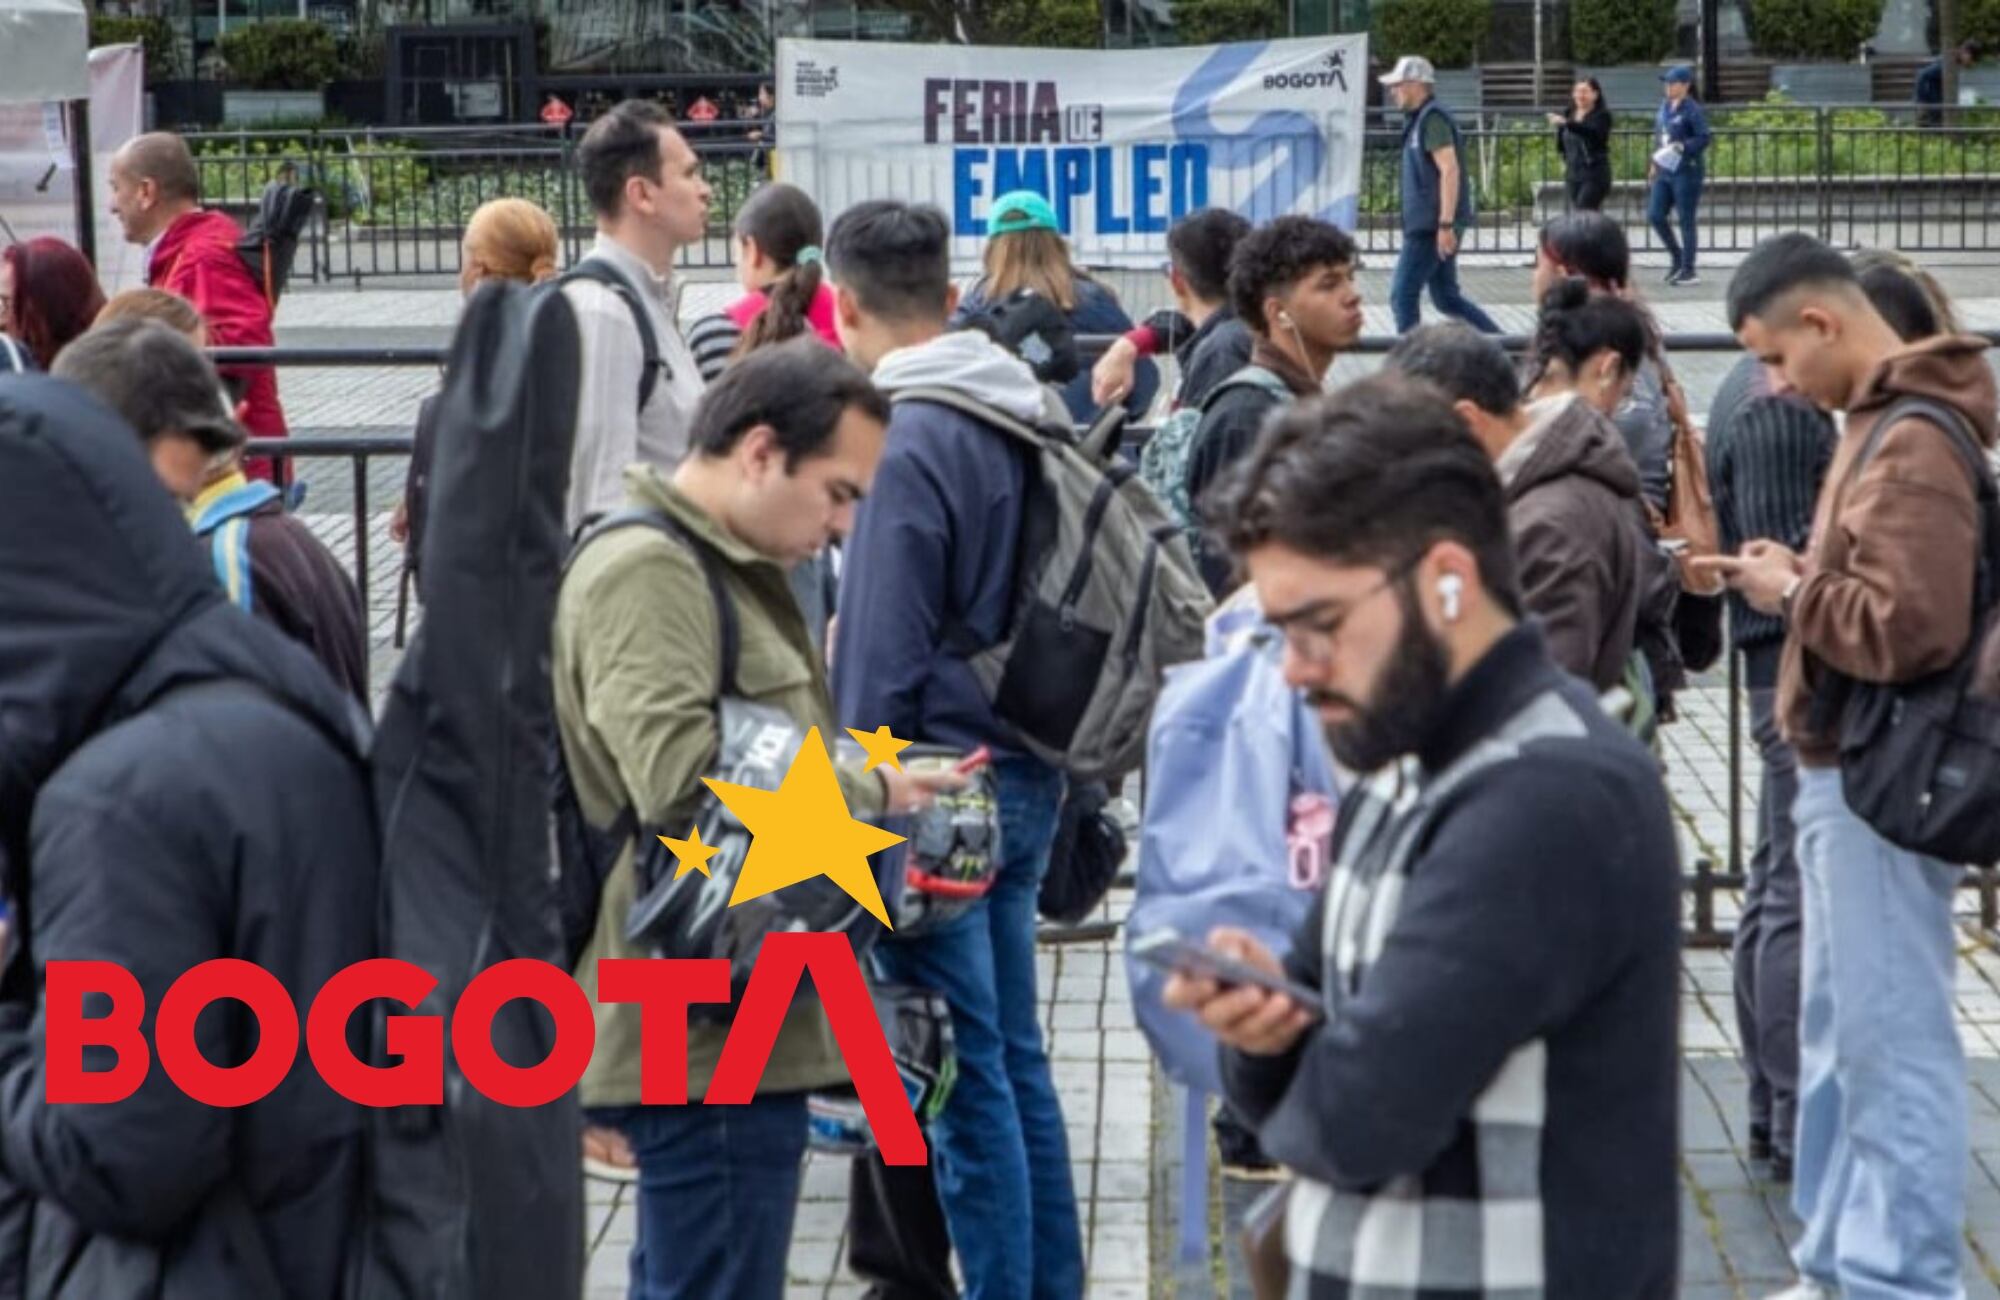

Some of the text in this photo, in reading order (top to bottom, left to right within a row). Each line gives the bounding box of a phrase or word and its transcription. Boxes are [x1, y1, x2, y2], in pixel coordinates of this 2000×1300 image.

[924, 78, 1104, 143] FERIA DE
[954, 144, 1208, 236] EMPLEO
